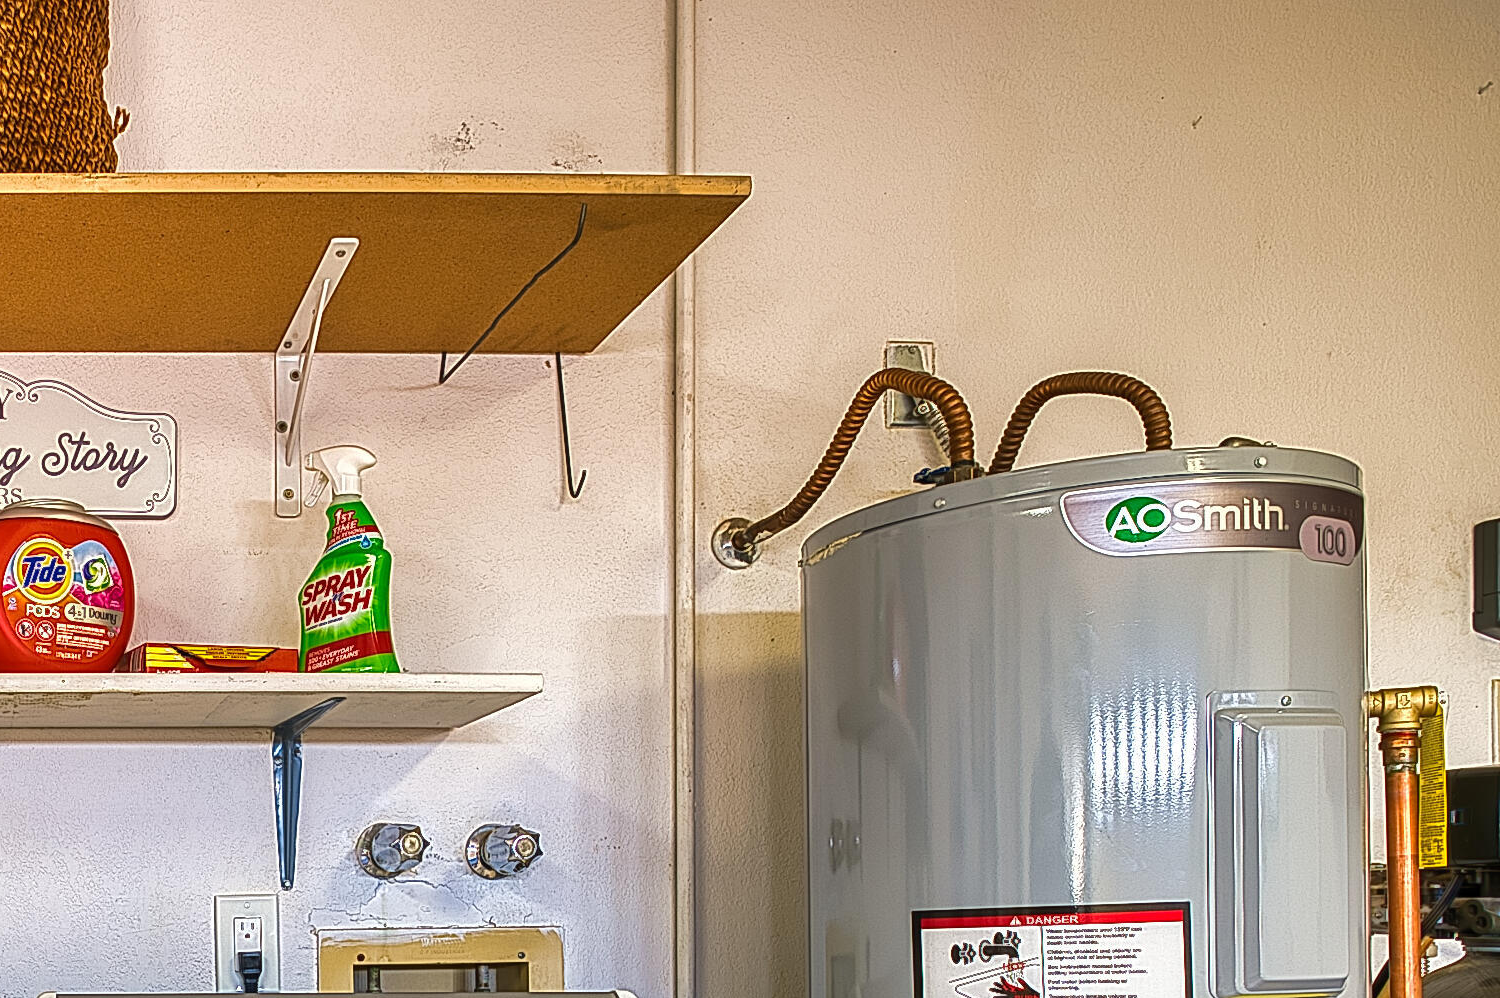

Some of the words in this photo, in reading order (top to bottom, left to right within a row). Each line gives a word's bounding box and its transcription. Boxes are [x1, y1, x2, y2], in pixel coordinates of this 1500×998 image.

[41, 432, 148, 488] Story
[333, 520, 358, 537] TIME
[1314, 524, 1346, 557] 100
[22, 556, 67, 588] Tide
[302, 565, 372, 605] SPRAY
[26, 603, 61, 619] PODS
[88, 607, 118, 625] Downy
[305, 588, 372, 627] WASH
[322, 644, 355, 661] EVERYDAY
[335, 650, 360, 663] STAINS
[1026, 914, 1079, 926] DANGER
[1002, 962, 1025, 971] HOT
